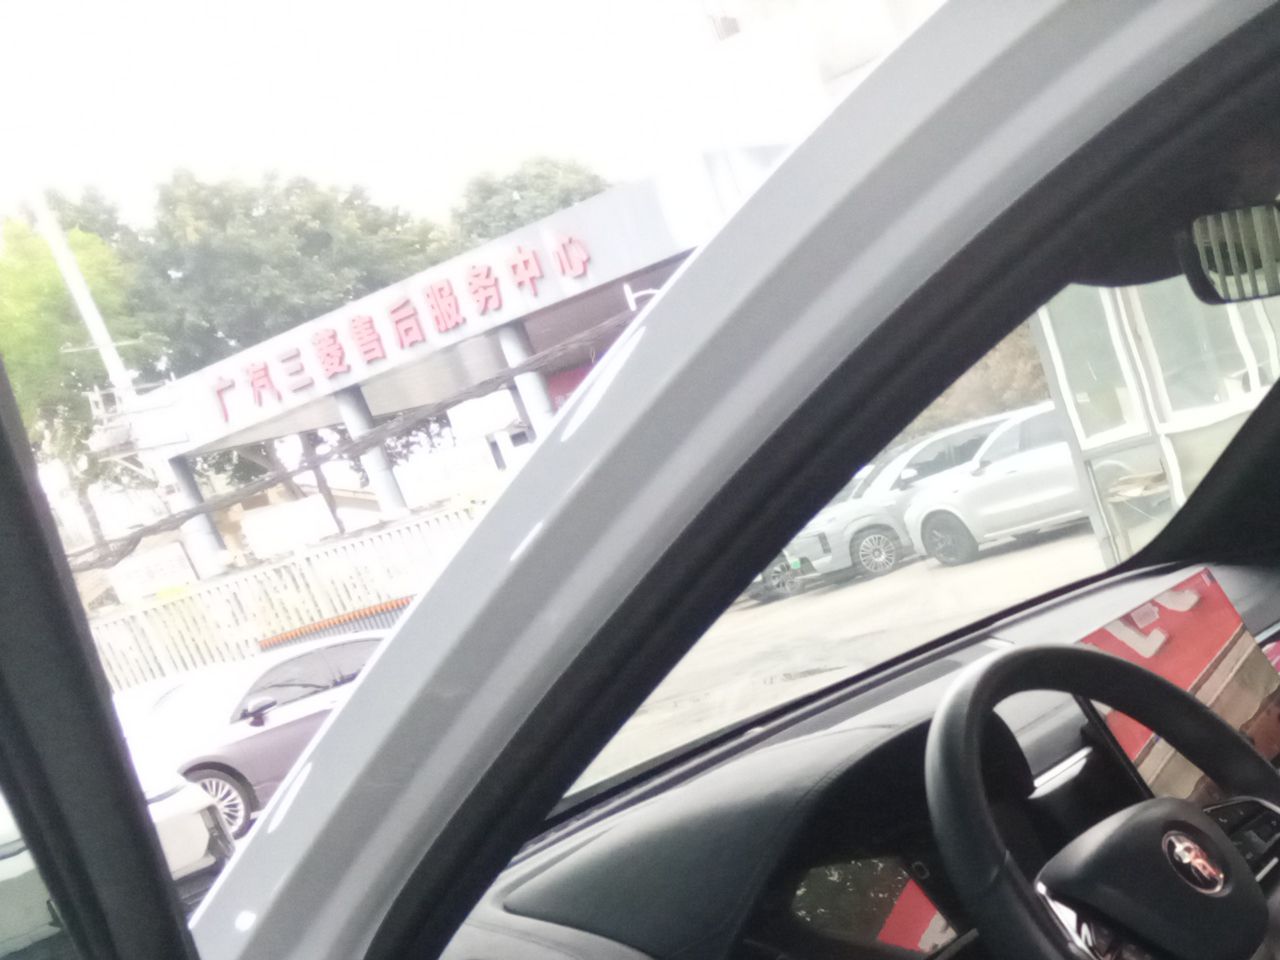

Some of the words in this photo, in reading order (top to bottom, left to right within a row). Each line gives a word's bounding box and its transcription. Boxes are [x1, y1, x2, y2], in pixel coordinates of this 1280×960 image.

[212, 233, 591, 422] 广汽三菱售后服务中心
